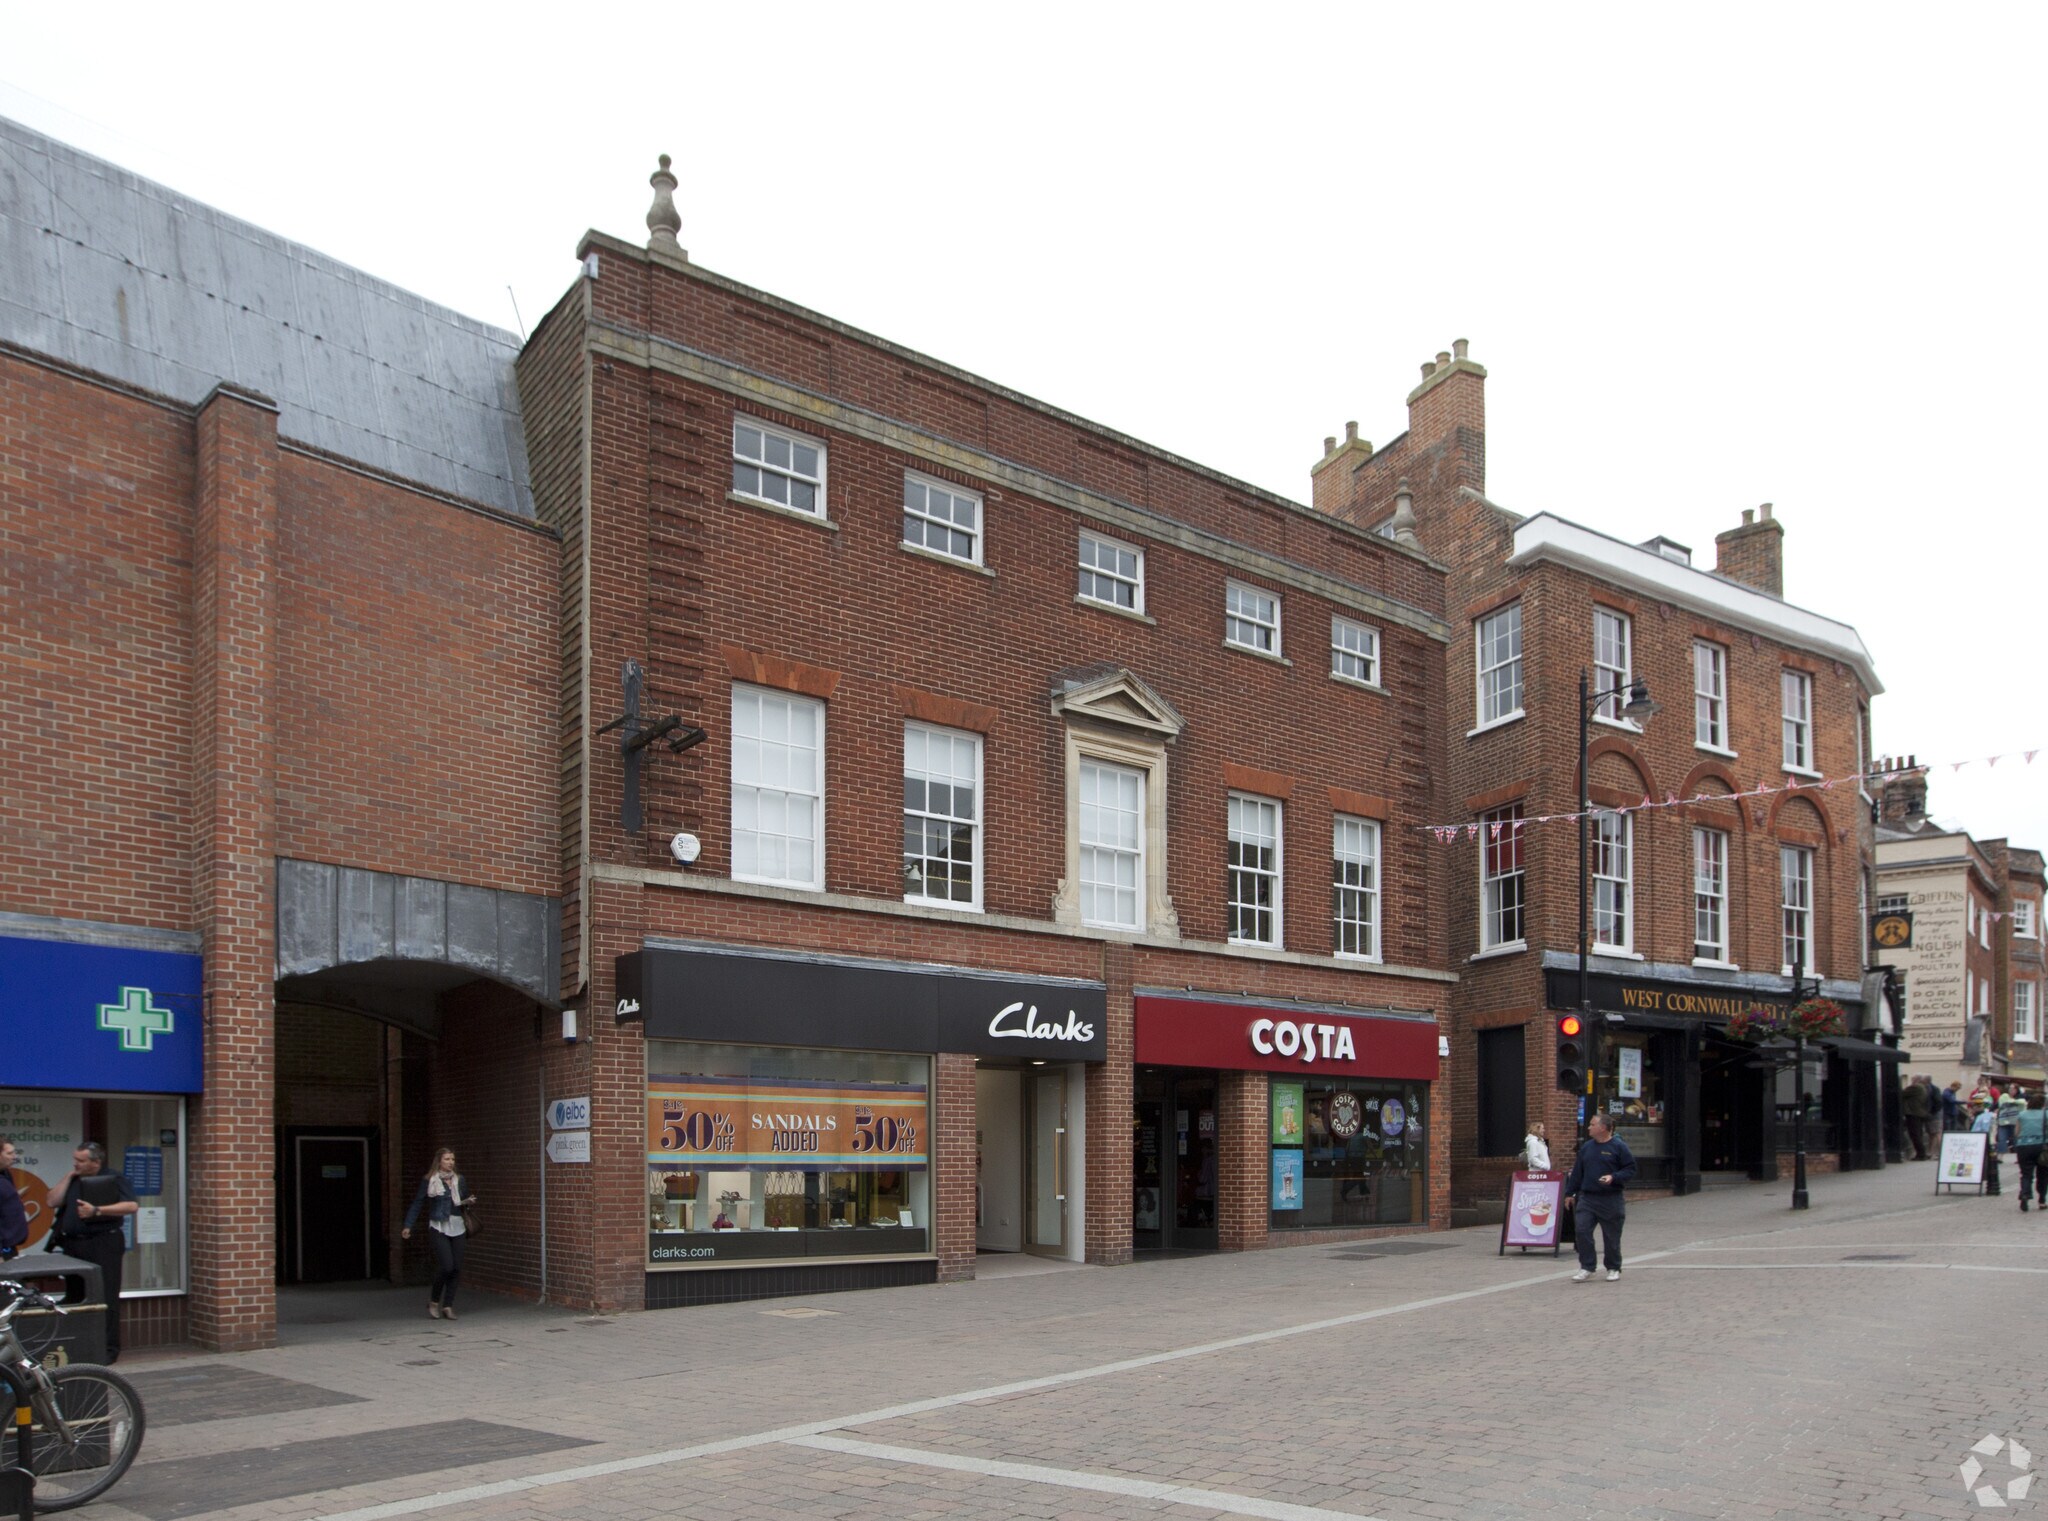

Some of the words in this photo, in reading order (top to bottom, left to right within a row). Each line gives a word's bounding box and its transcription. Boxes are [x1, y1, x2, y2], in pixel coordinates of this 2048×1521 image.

[1908, 940, 1962, 953] ENGLISH
[1920, 951, 1952, 960] MEAT
[1910, 962, 1960, 971] POULTRY
[1913, 989, 1957, 998] PORK
[1622, 987, 1663, 1009] WEST
[1666, 992, 1744, 1018] CORNWALL
[1912, 1002, 1962, 1010] BACON
[988, 1001, 1095, 1042] Clarks
[1250, 1018, 1356, 1063] COSTA
[1910, 1031, 1962, 1039] SPECIALITY
[1334, 1094, 1355, 1107] COSTA
[14, 1102, 43, 1115] you
[12, 1115, 51, 1128] most
[751, 1113, 837, 1131] SANDALS
[1333, 1118, 1358, 1134] COFFEE
[660, 1111, 735, 1152] 50%
[852, 1115, 916, 1153] 50%
[715, 1137, 735, 1152] OFF
[771, 1131, 819, 1153] ADDED
[899, 1138, 916, 1153] OFF
[652, 1246, 715, 1259] clarks.com
